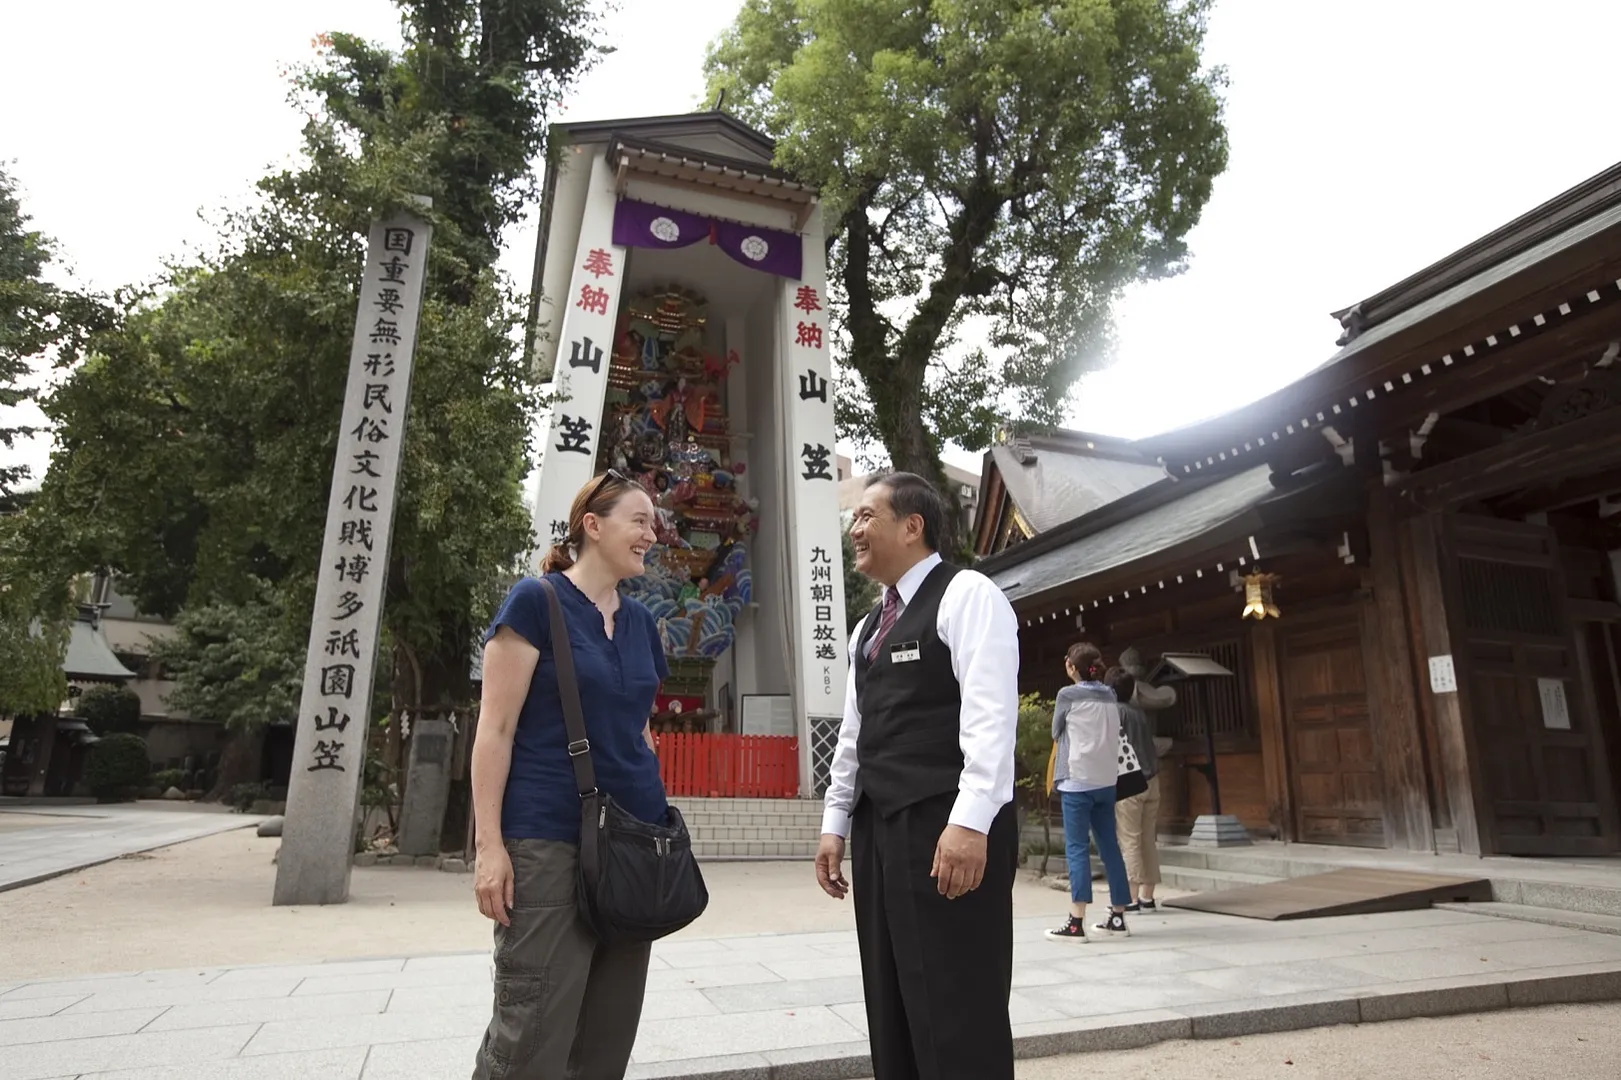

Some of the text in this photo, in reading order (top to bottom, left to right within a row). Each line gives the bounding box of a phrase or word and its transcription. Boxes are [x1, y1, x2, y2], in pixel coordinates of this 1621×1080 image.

[575, 247, 615, 318] 奉納
[554, 336, 605, 457] 山笠
[793, 284, 837, 695] 奉納 山笠 九州朝日放送 KBC
